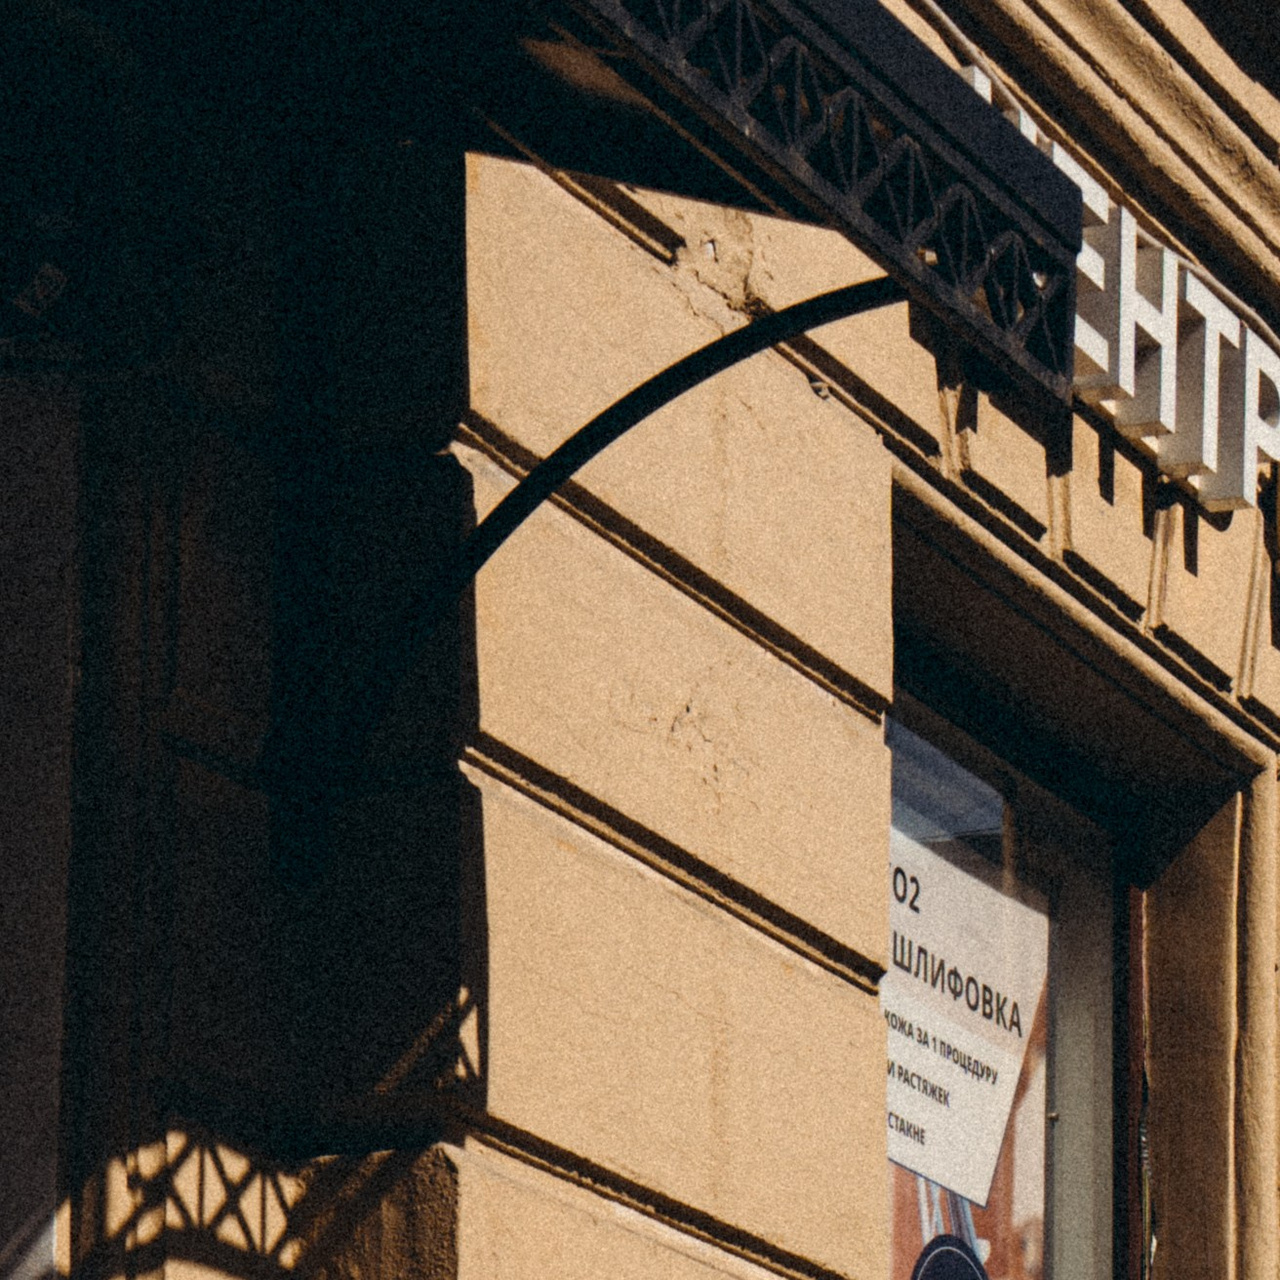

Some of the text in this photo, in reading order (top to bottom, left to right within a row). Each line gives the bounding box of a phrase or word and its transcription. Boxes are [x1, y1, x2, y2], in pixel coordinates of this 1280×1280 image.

[893, 930, 1022, 1038] ШЛИФОВКА
[916, 1026, 930, 1049] ЗА
[932, 1036, 937, 1053] 1
[939, 1040, 998, 1085] ПРОЦЕДУРУ
[898, 1065, 950, 1108] РАСТЯЖЕК
